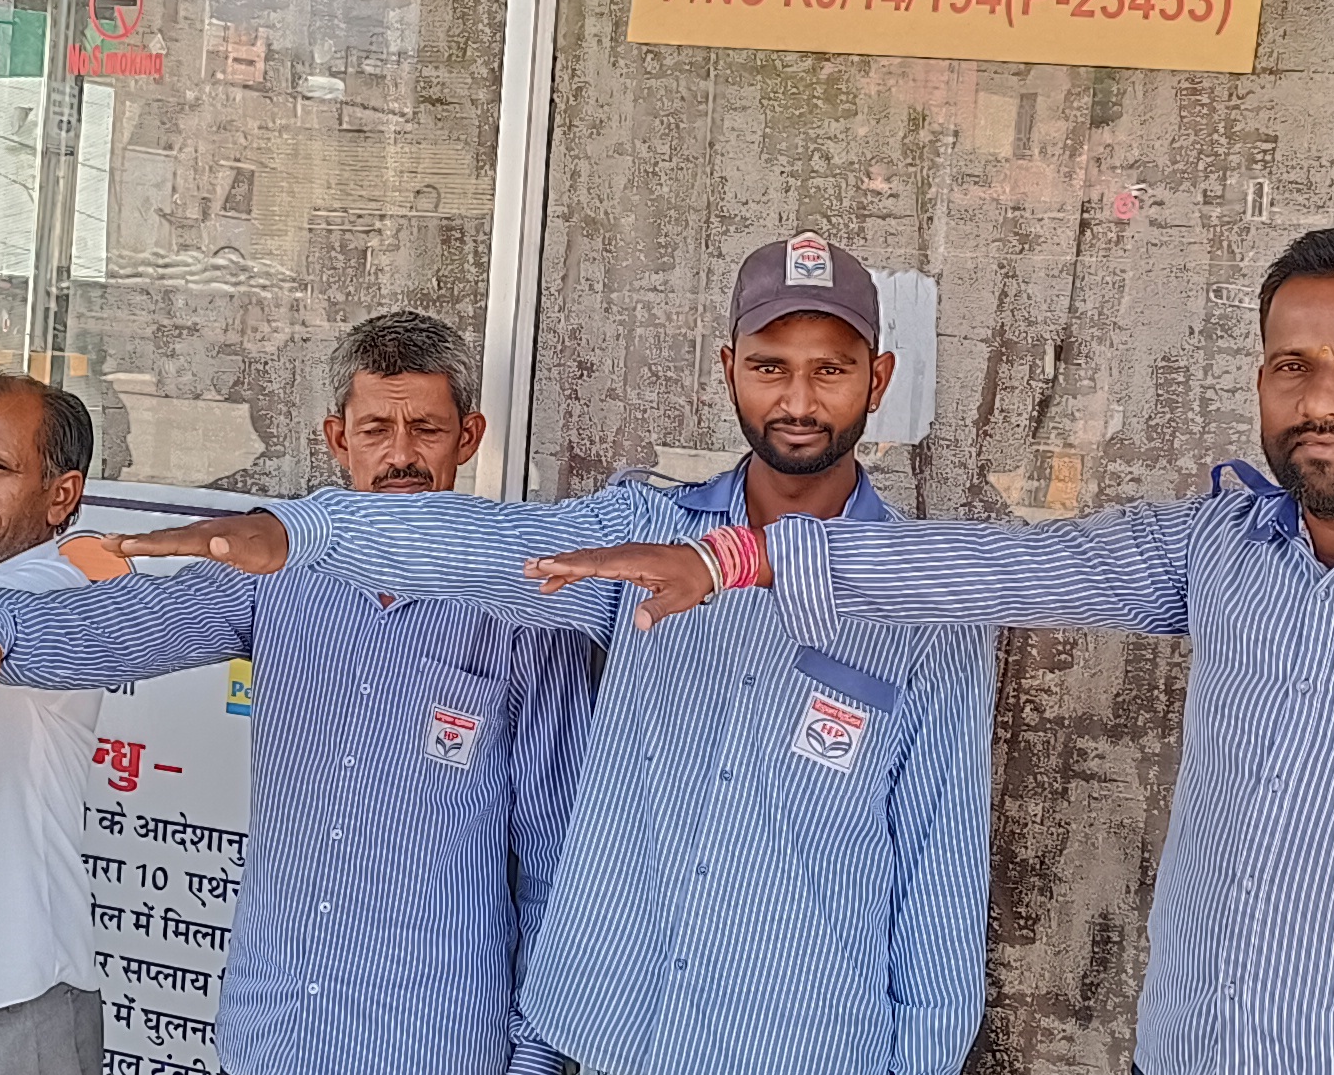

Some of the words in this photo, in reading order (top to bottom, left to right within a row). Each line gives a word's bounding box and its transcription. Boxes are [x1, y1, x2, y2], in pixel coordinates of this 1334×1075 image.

[68, 43, 89, 76] No
[96, 801, 127, 836] के
[134, 811, 249, 867] आदेशानु
[136, 864, 168, 891] 10
[130, 901, 154, 938] में
[160, 908, 232, 952] मिला
[119, 955, 212, 997] सप्लाय
[112, 993, 136, 1029] में
